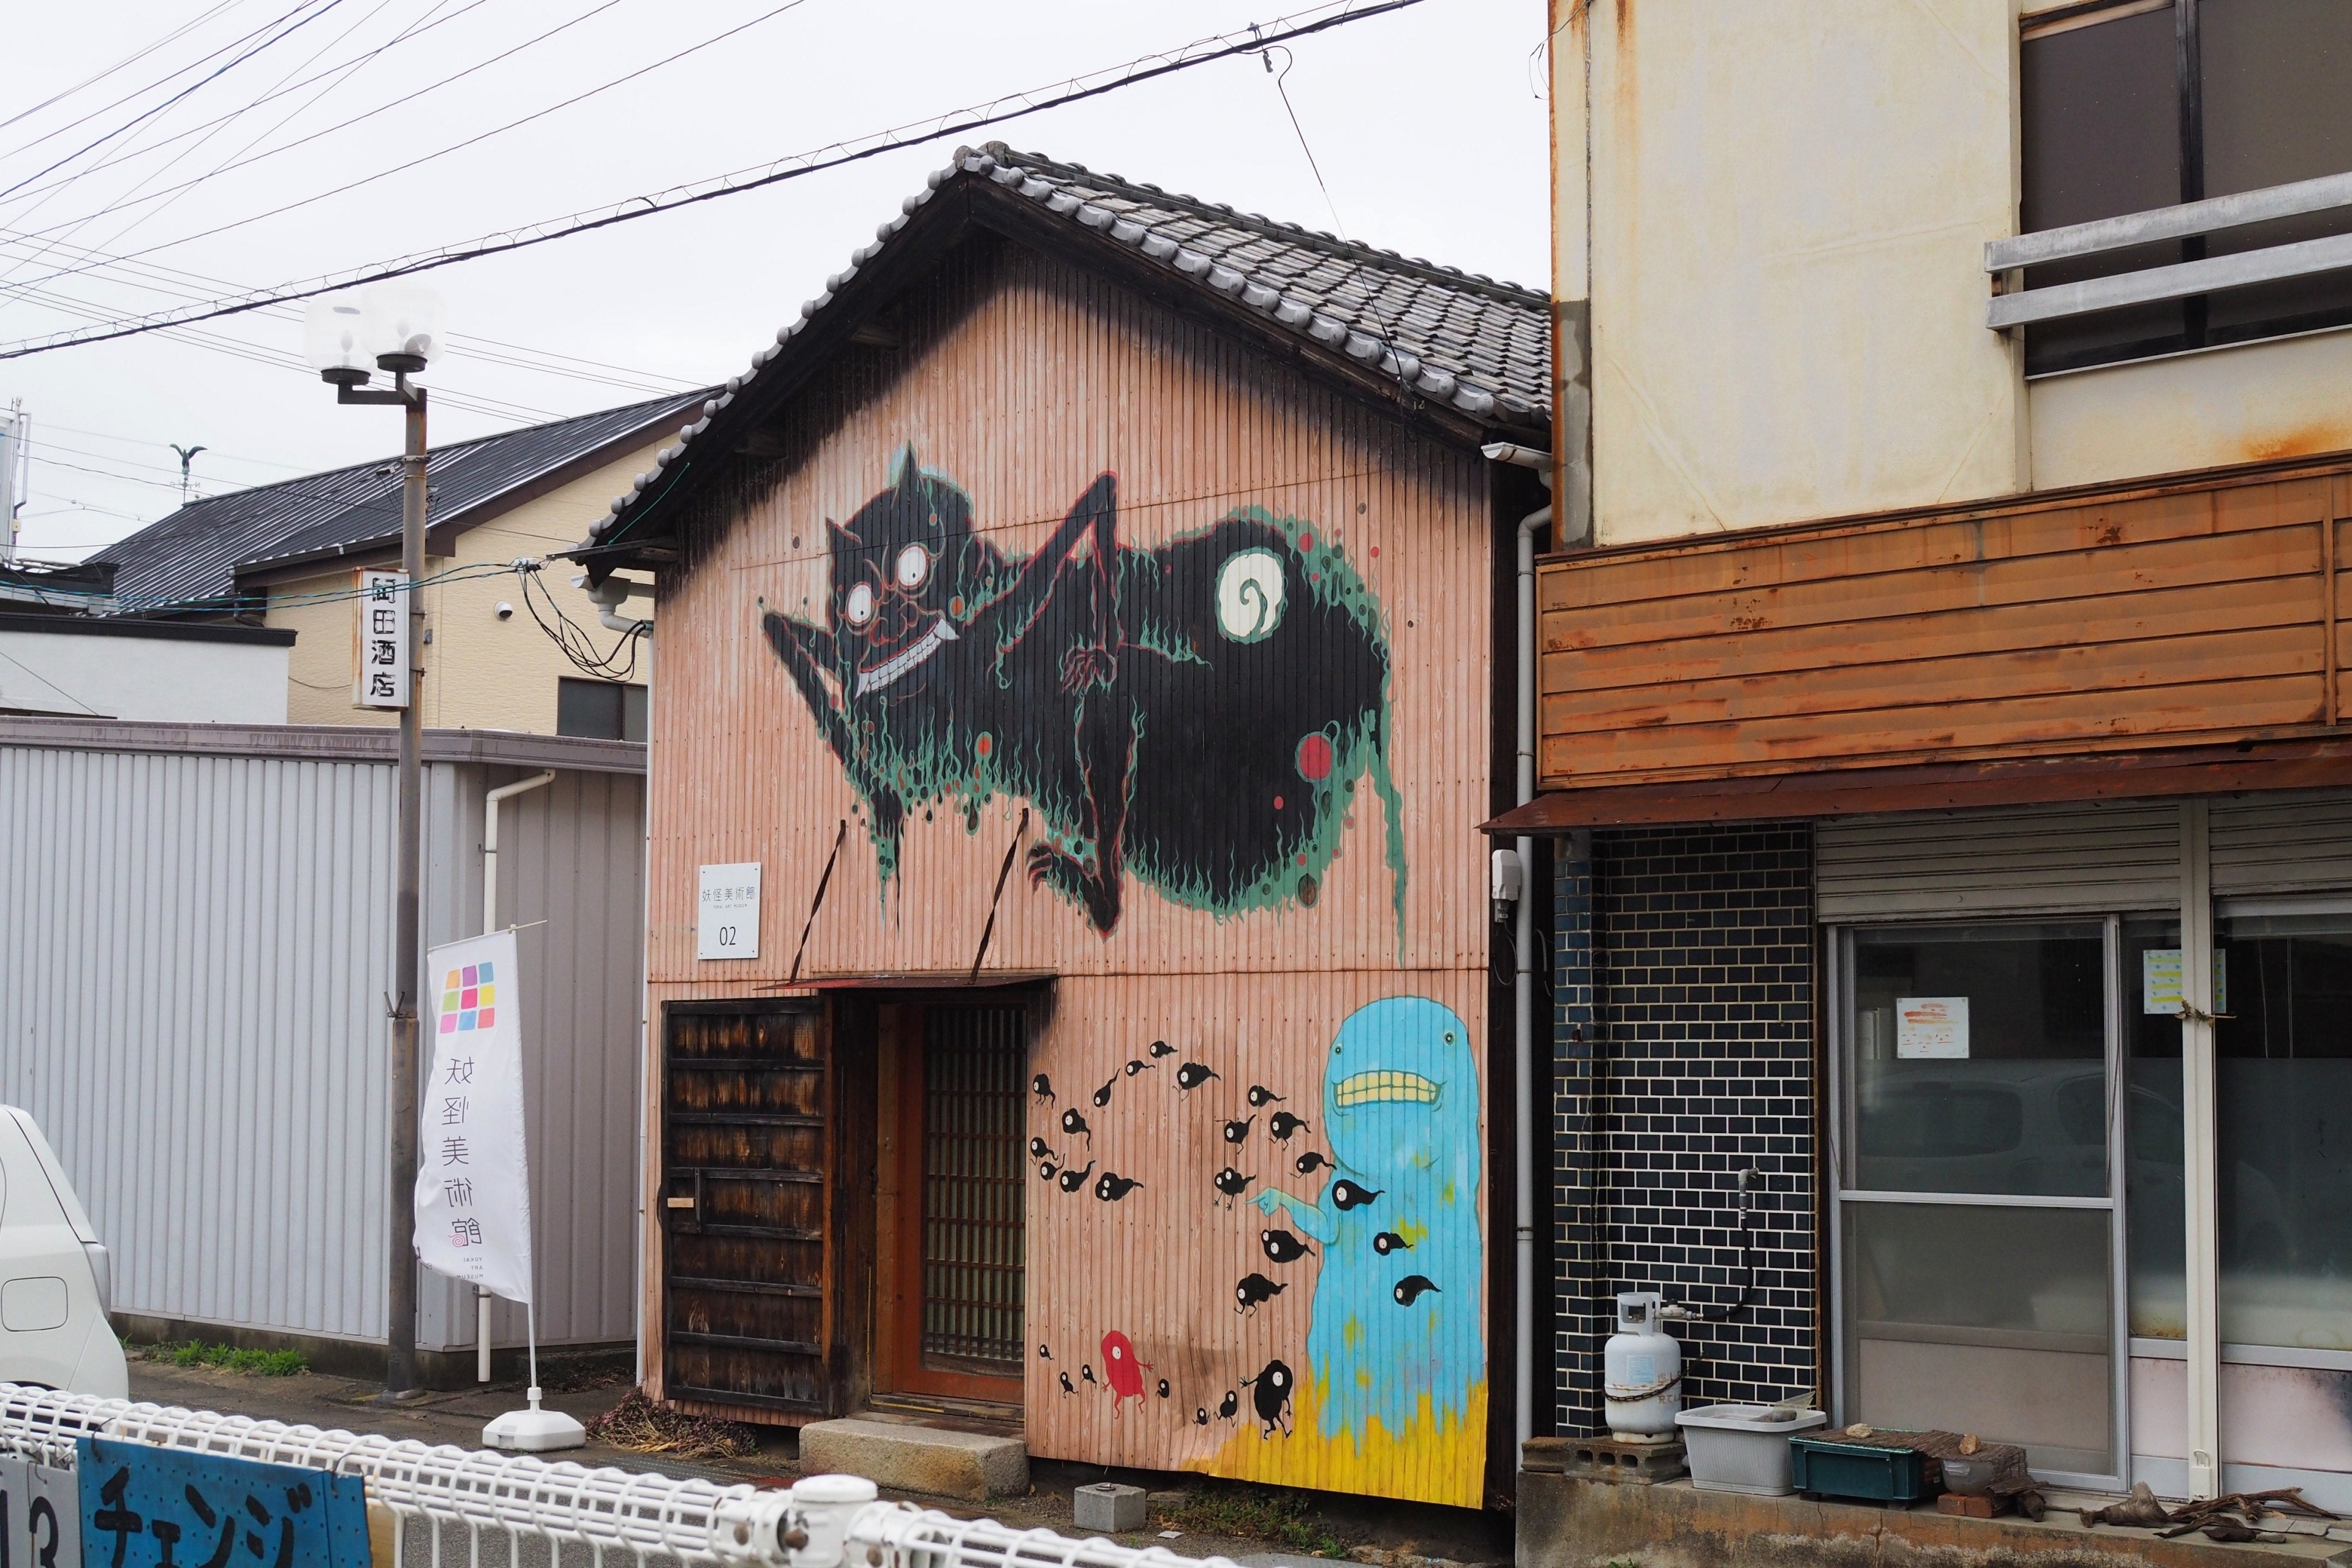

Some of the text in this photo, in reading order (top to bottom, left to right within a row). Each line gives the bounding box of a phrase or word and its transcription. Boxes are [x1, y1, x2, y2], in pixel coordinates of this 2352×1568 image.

[702, 886, 756, 902] 妖怪美術館
[719, 926, 736, 946] 02
